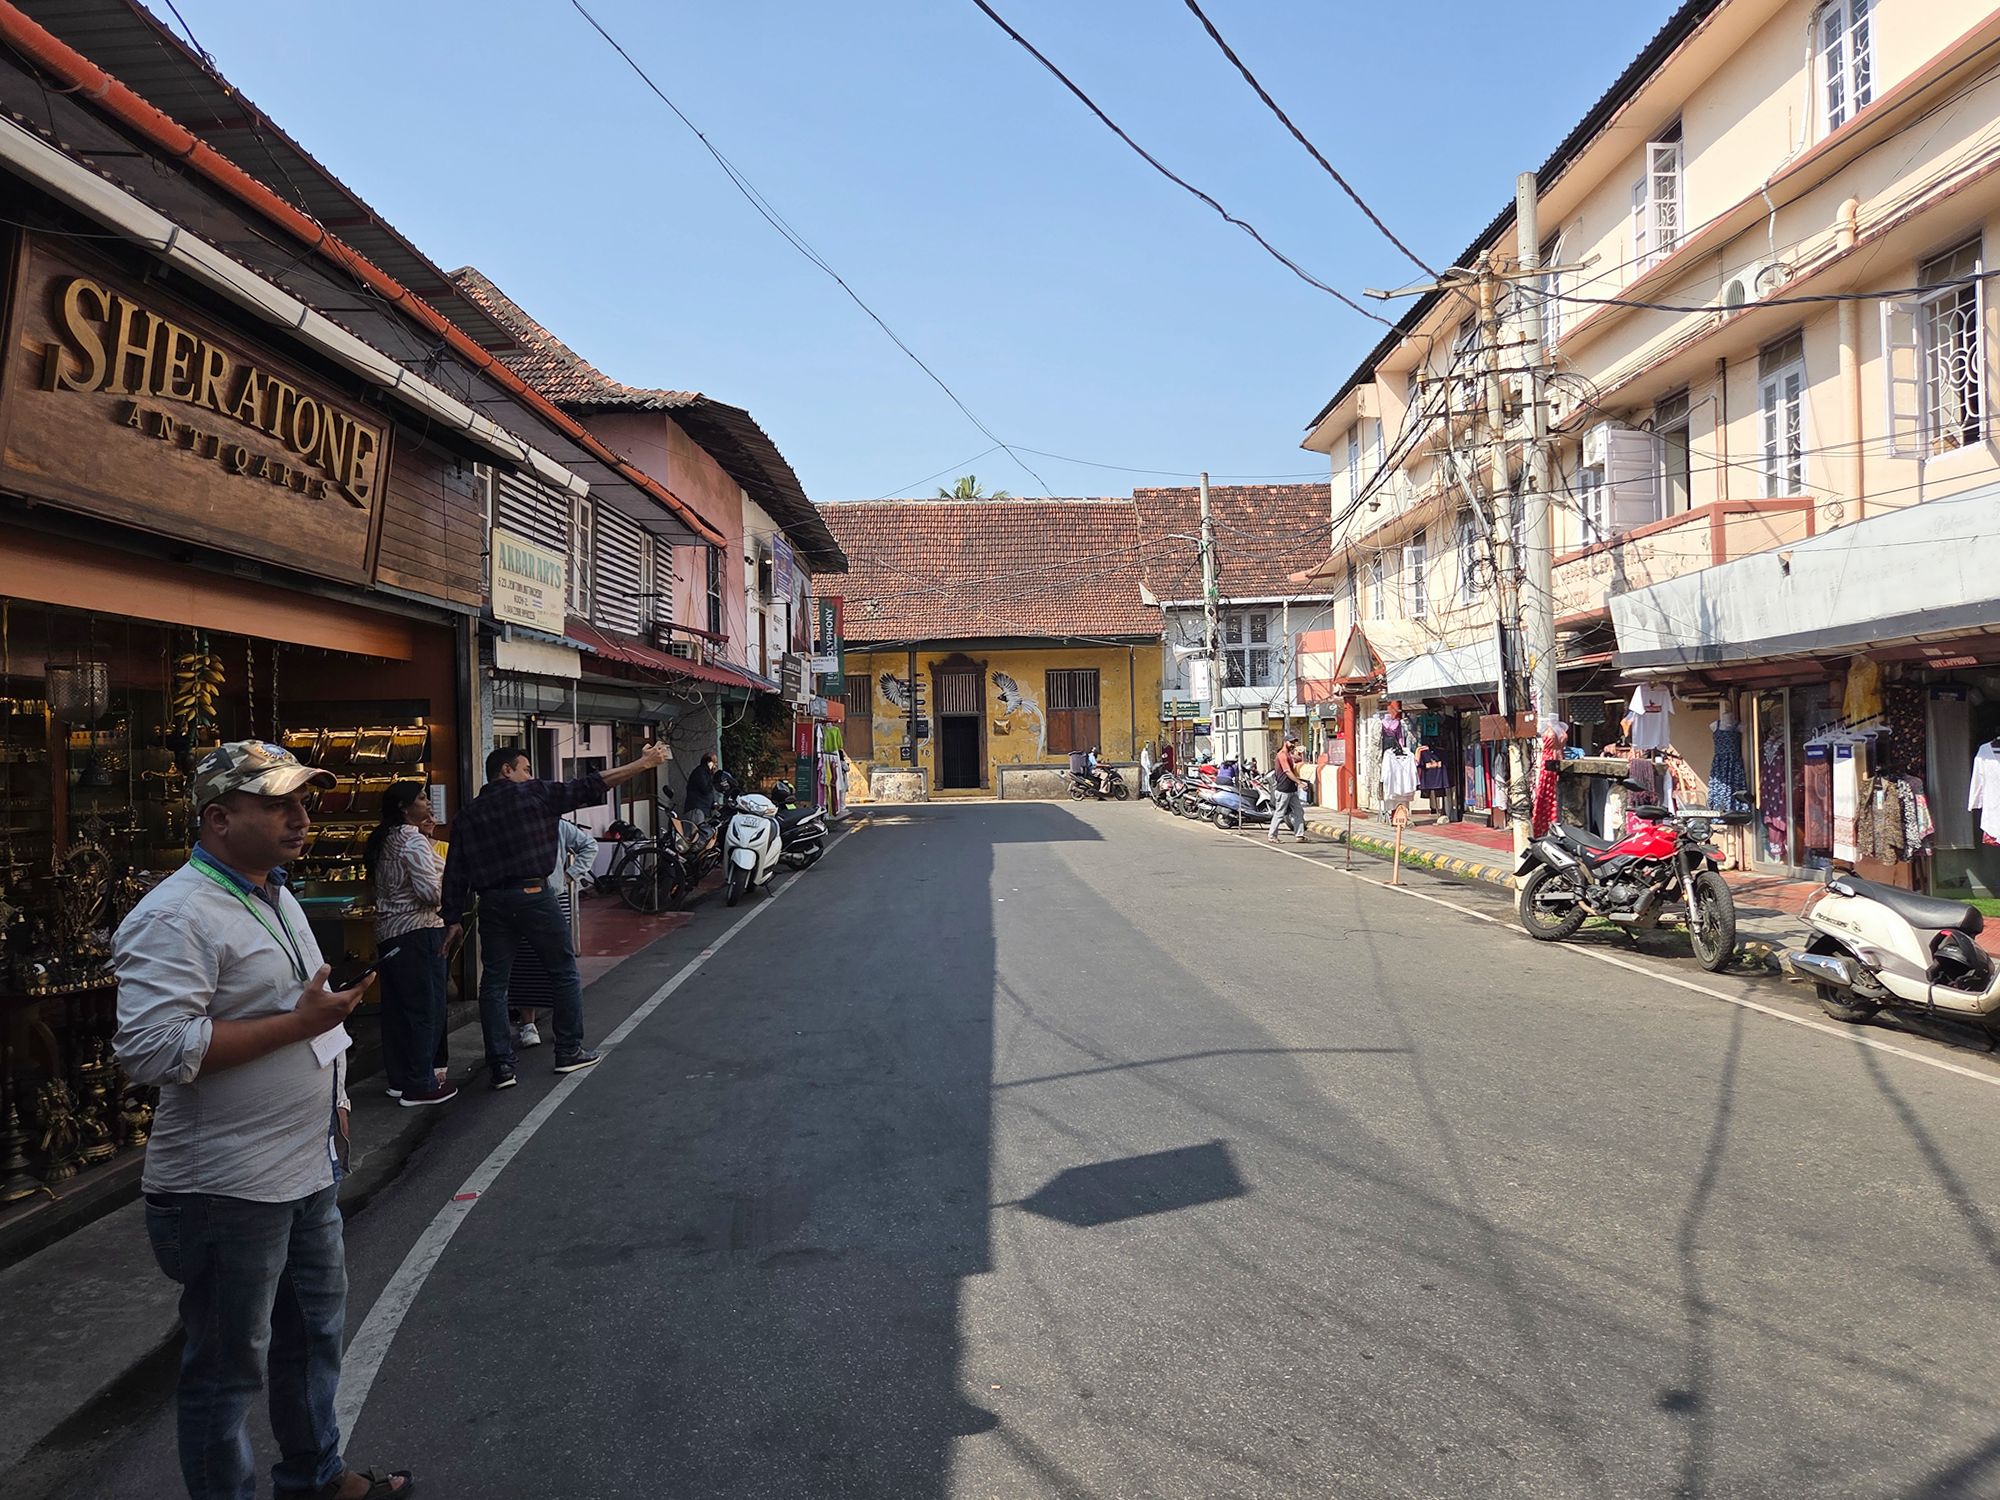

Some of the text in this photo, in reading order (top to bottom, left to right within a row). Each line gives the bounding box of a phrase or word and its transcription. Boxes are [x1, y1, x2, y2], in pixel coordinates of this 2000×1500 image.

[46, 277, 377, 508] SHERATONE
[126, 402, 329, 500] ANTIQARTS
[498, 542, 562, 590] AKBAR ARTS
[825, 606, 833, 658] OLYPHONY
